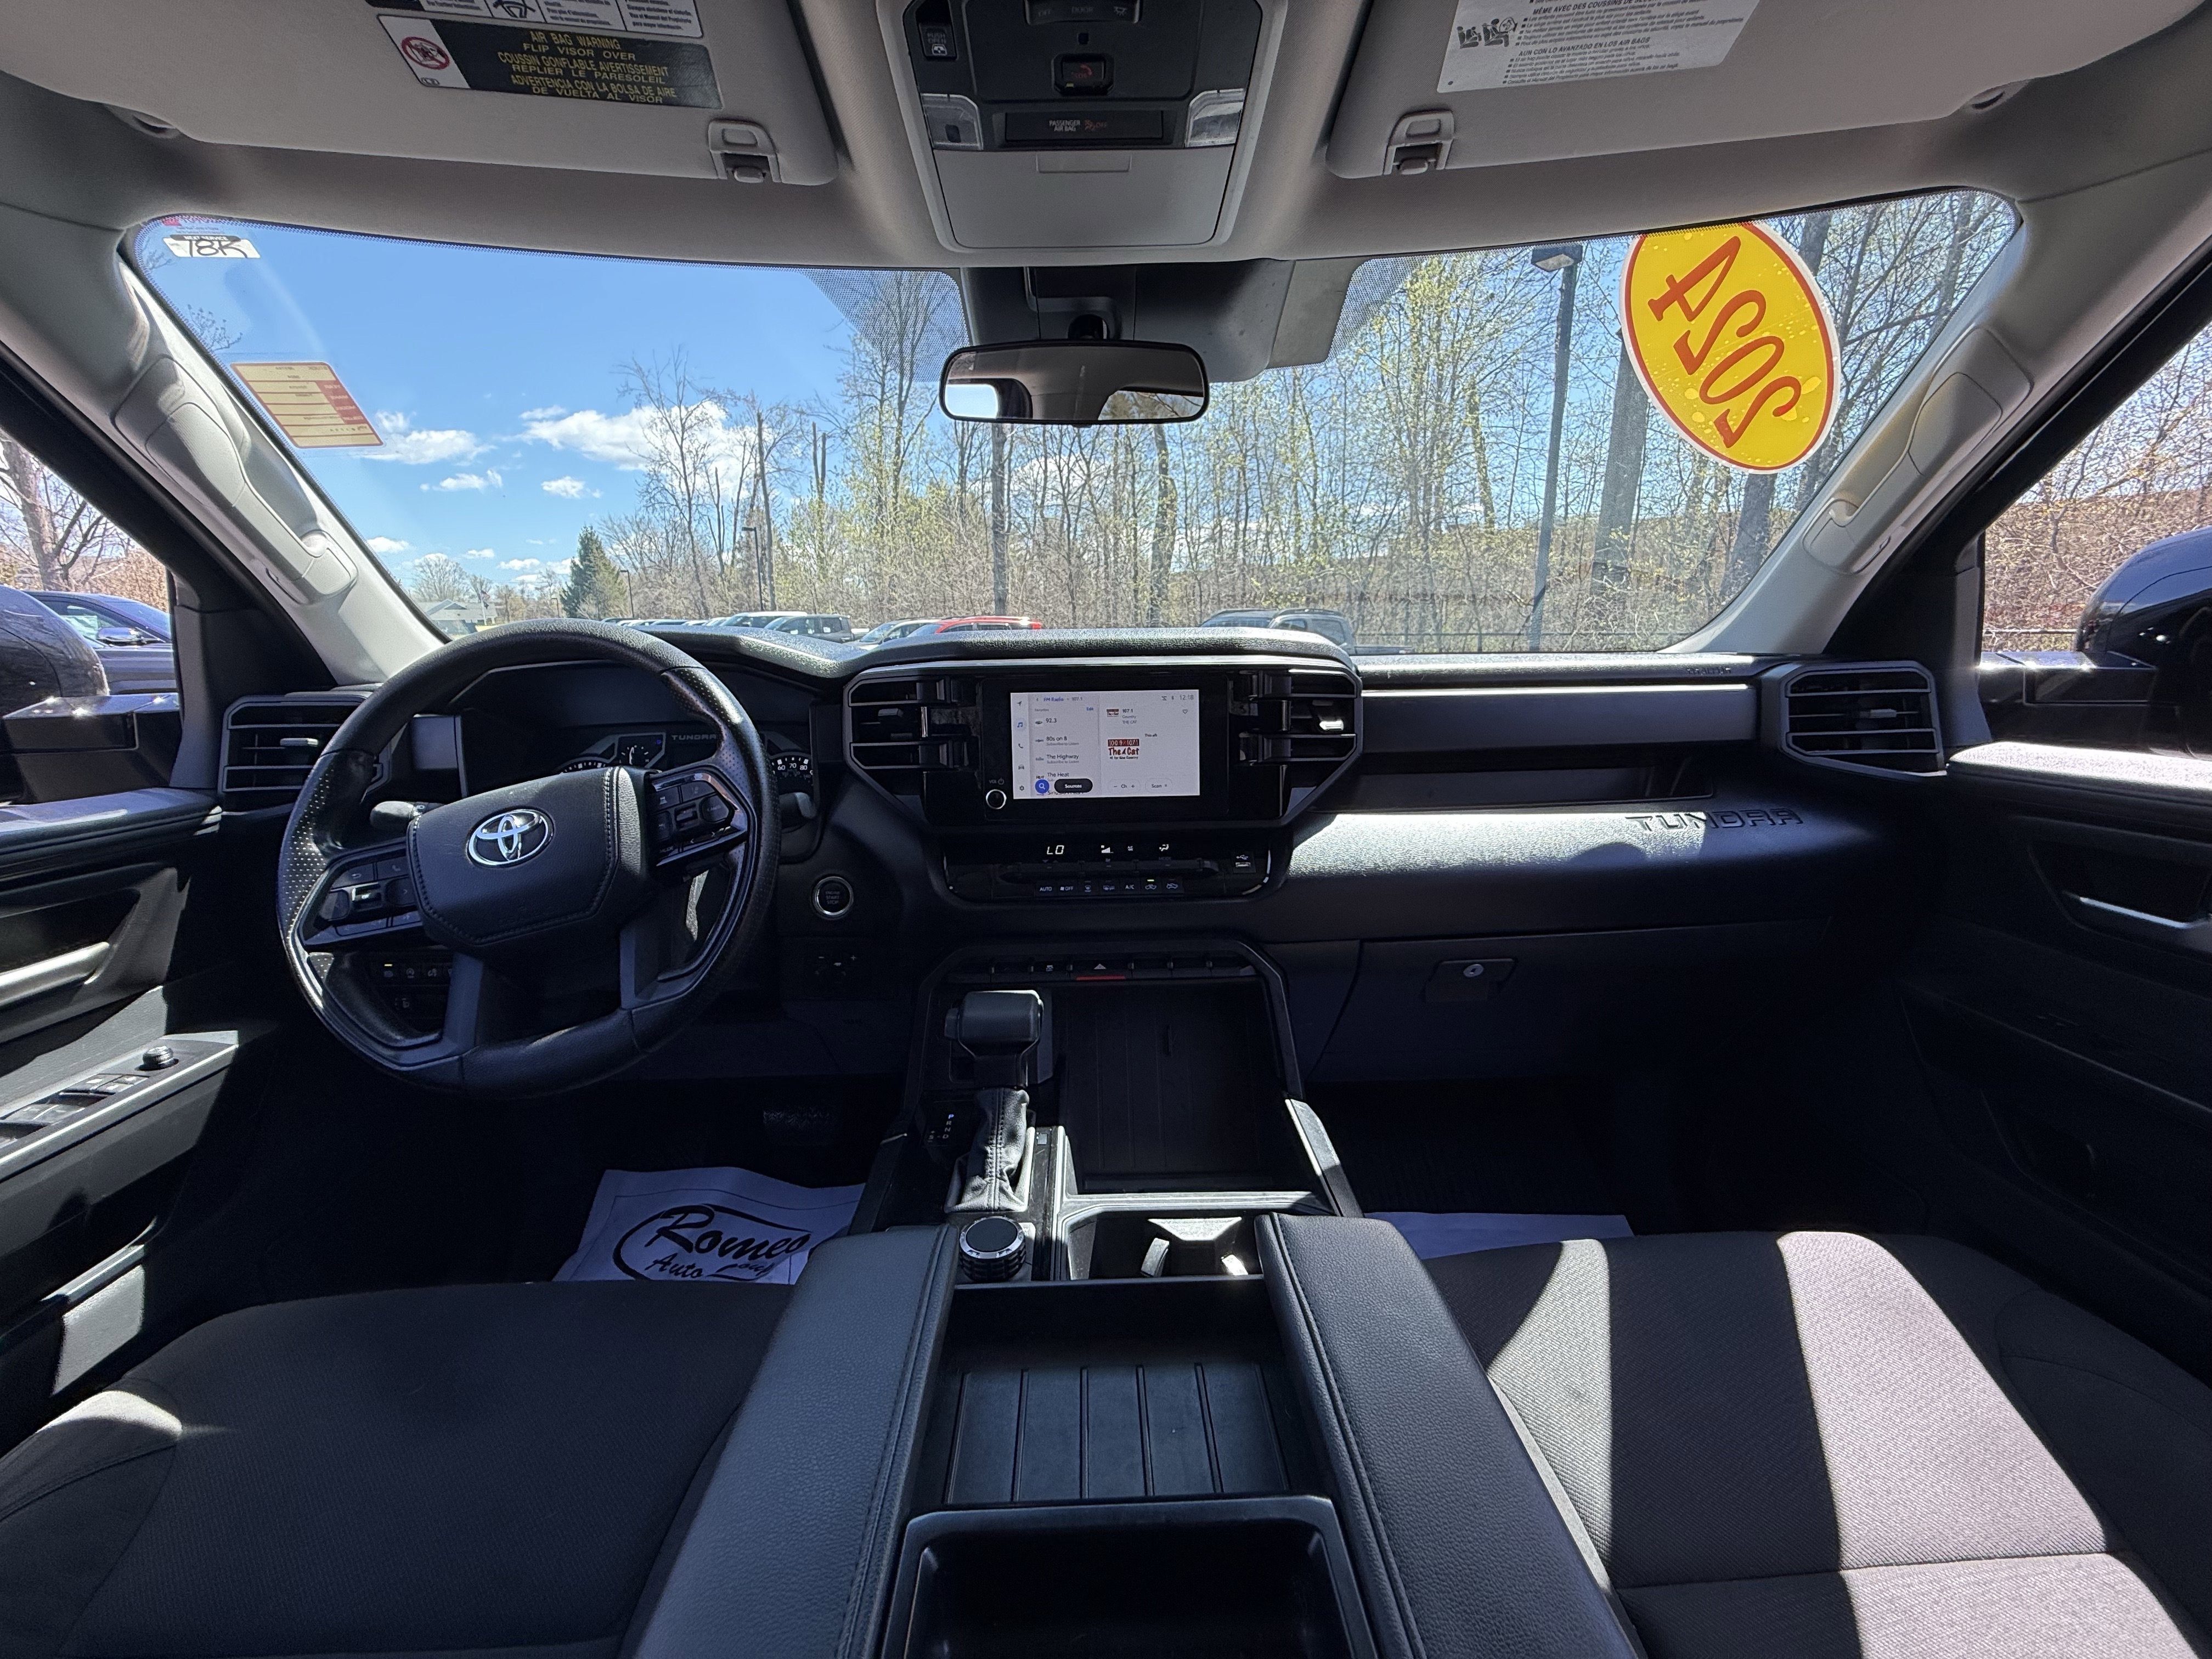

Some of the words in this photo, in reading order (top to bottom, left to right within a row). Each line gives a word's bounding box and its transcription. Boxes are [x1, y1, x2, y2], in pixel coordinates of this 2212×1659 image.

[530, 31, 548, 43] AIR
[550, 33, 573, 46] BAG
[577, 35, 620, 50] WARNING
[523, 43, 549, 53] FLIP
[557, 46, 595, 58] VISOR
[602, 50, 636, 61] OVER
[498, 52, 541, 66] COUSSIN
[541, 55, 597, 71] GONFLABLE
[600, 60, 669, 77] AVERTISSEMENT
[512, 64, 564, 76] REPLIER
[572, 70, 586, 78] LE
[594, 71, 665, 84] PARESOLEIL
[510, 75, 573, 89] ADVERTENCIA
[575, 80, 595, 92] CON
[596, 82, 608, 93] LA
[611, 83, 640, 95] BOLSA
[642, 86, 656, 97] DE
[657, 87, 678, 98] AIRE
[533, 87, 548, 95] DE
[556, 88, 599, 99] VUELTA
[607, 92, 622, 101] AL
[629, 95, 663, 104] VISOR
[1108, 747, 1121, 756] The
[1127, 747, 1139, 756] Cat
[1625, 808, 1804, 832] TUNDRA
[644, 1205, 811, 1261] Romeo
[645, 1252, 703, 1278] Auto
